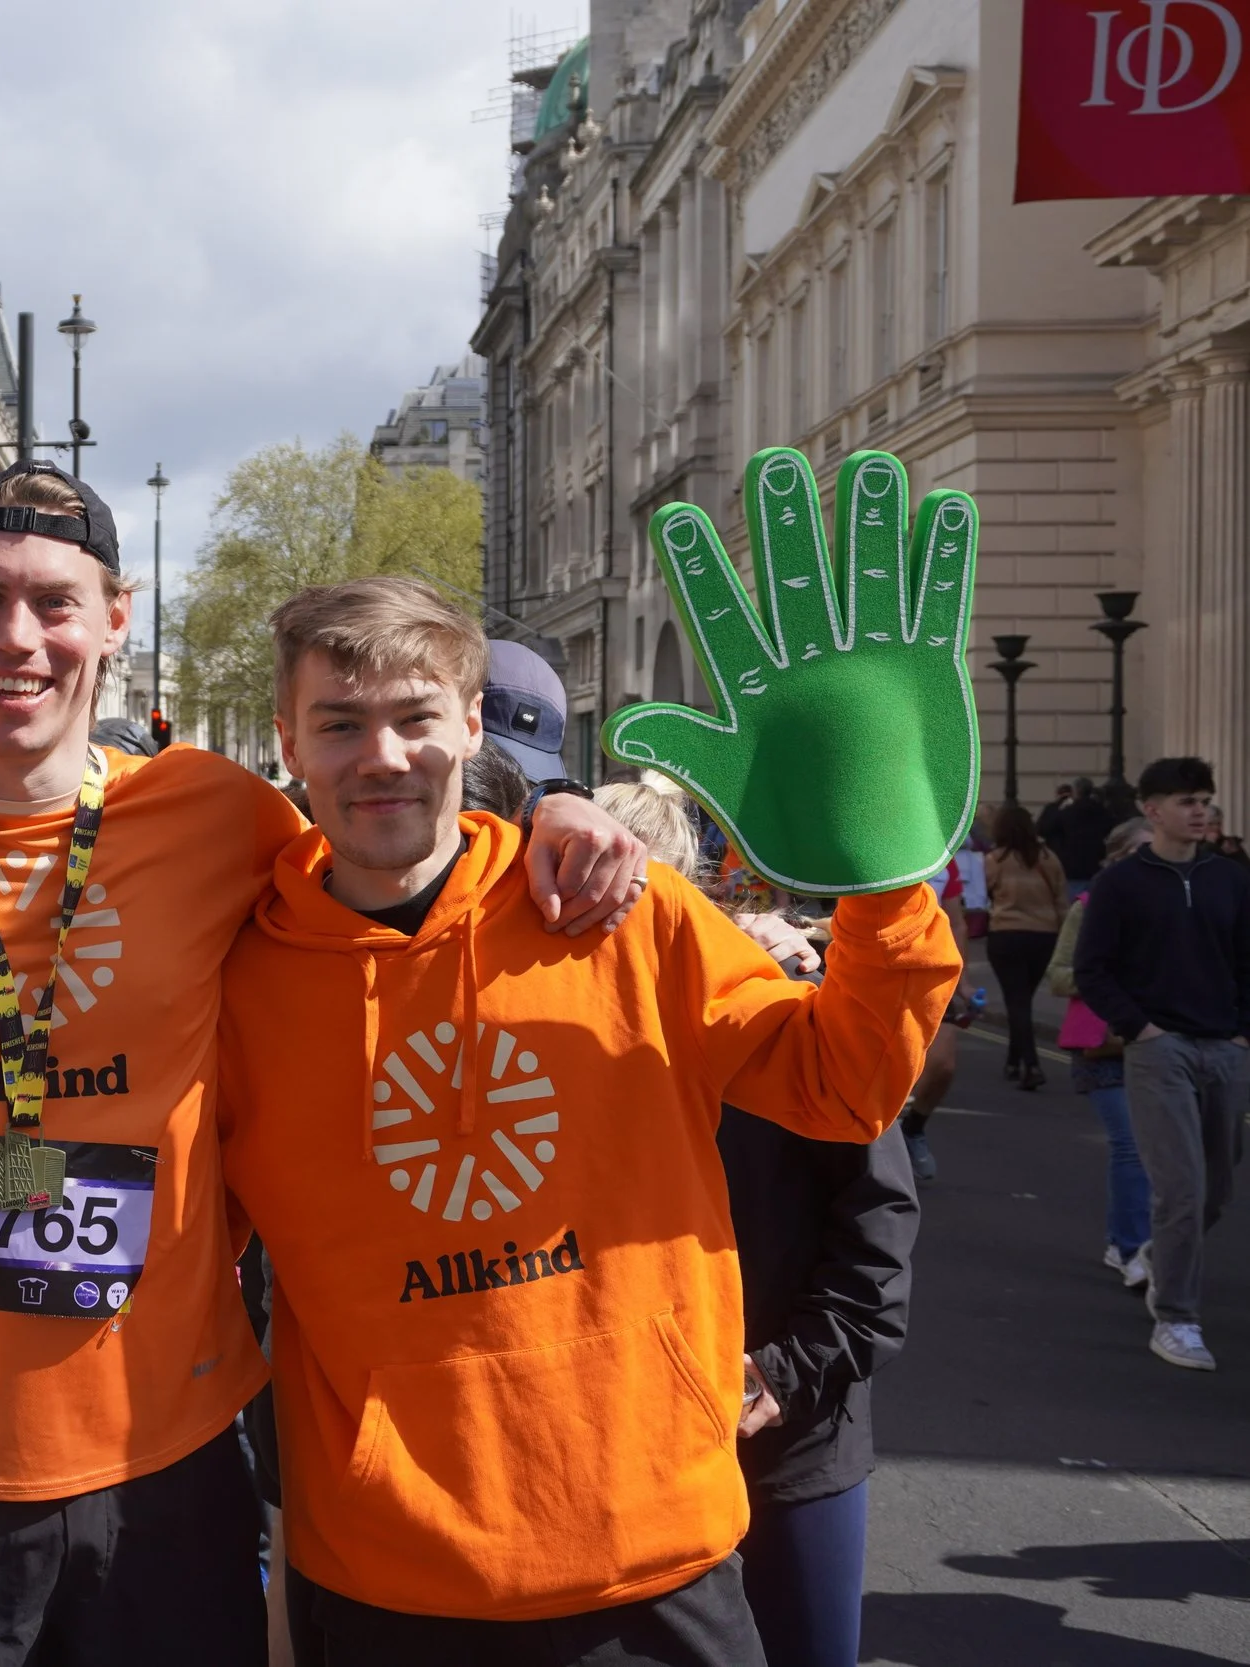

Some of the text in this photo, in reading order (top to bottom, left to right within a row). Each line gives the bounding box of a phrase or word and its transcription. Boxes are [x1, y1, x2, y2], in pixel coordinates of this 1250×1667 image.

[1, 1036, 26, 1050] FINISHER
[400, 1230, 585, 1303] Allkind
[30, 1288, 34, 1299] L
[115, 1294, 120, 1305] 1
